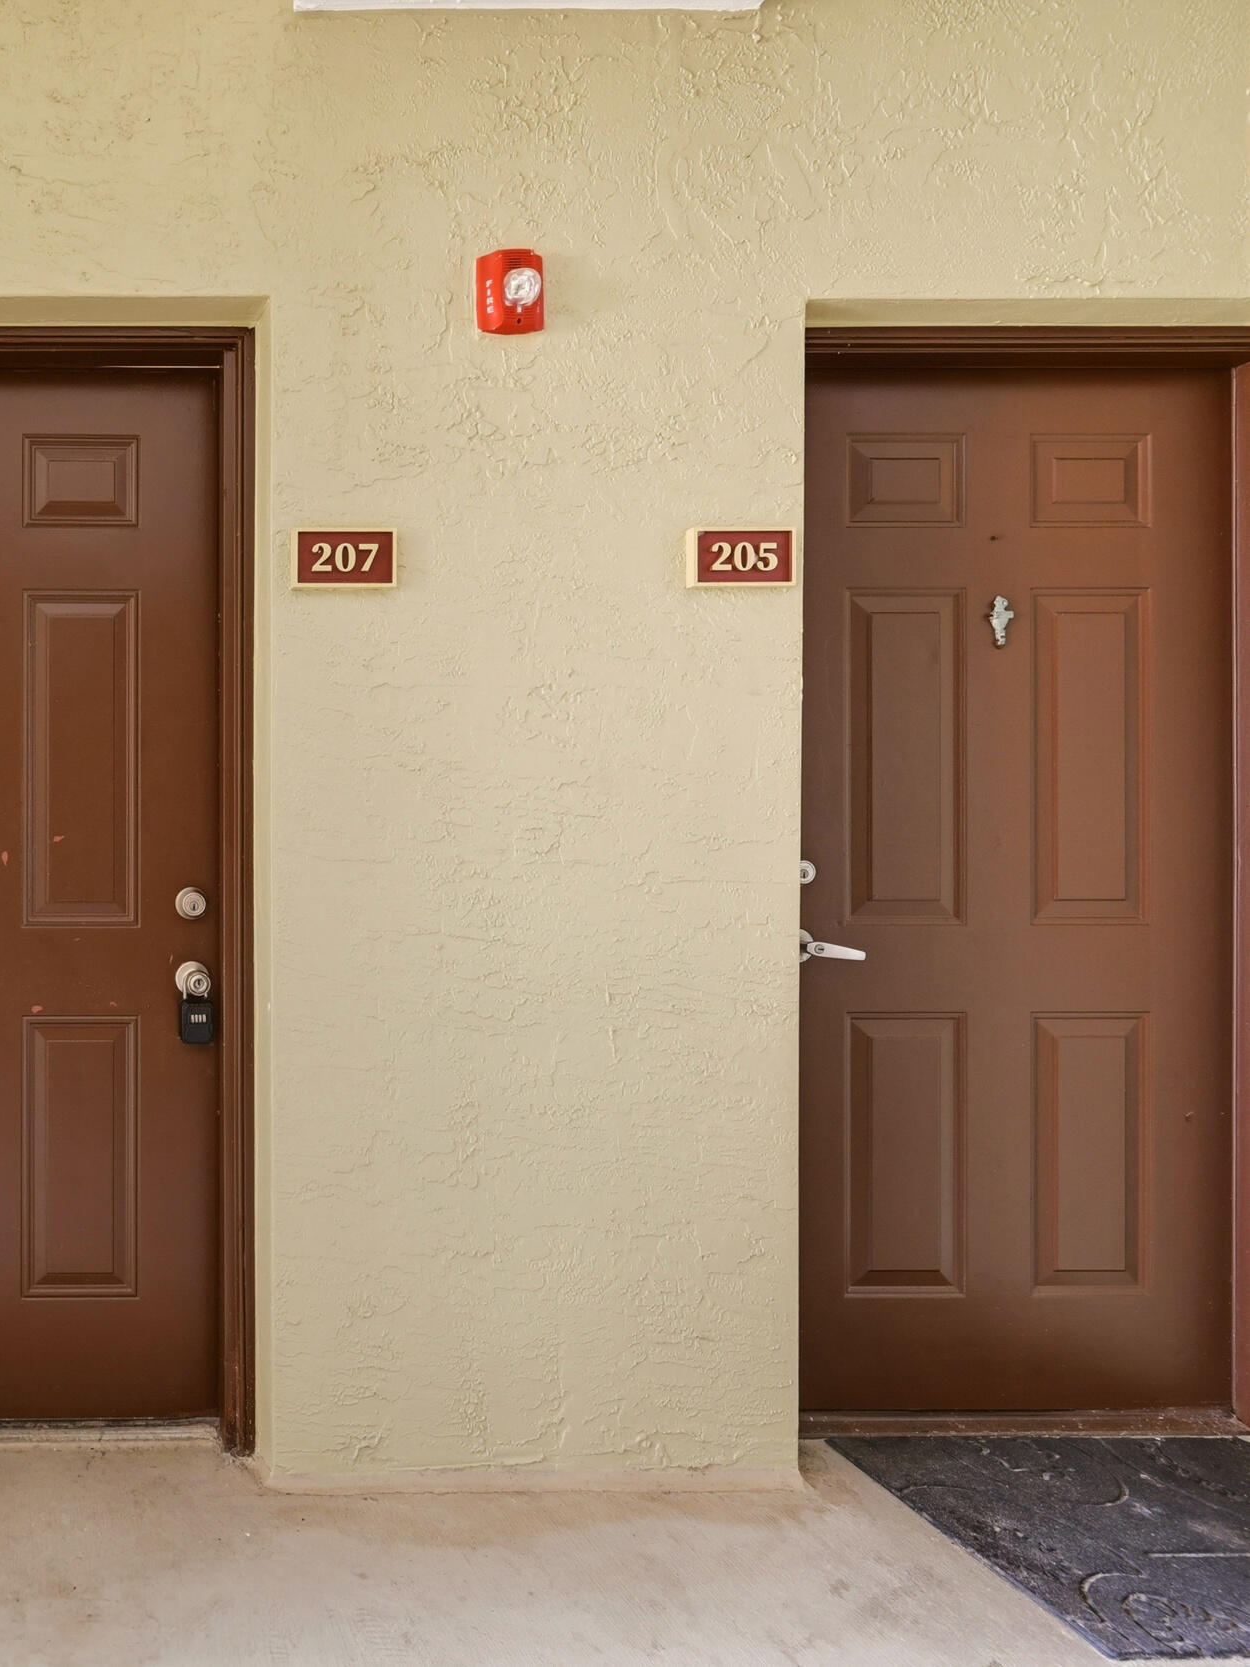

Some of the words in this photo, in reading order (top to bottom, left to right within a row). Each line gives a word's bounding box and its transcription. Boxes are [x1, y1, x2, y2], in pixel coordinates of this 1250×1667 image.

[486, 279, 494, 314] FIRE
[311, 542, 379, 572] 207
[711, 541, 778, 571] 205
